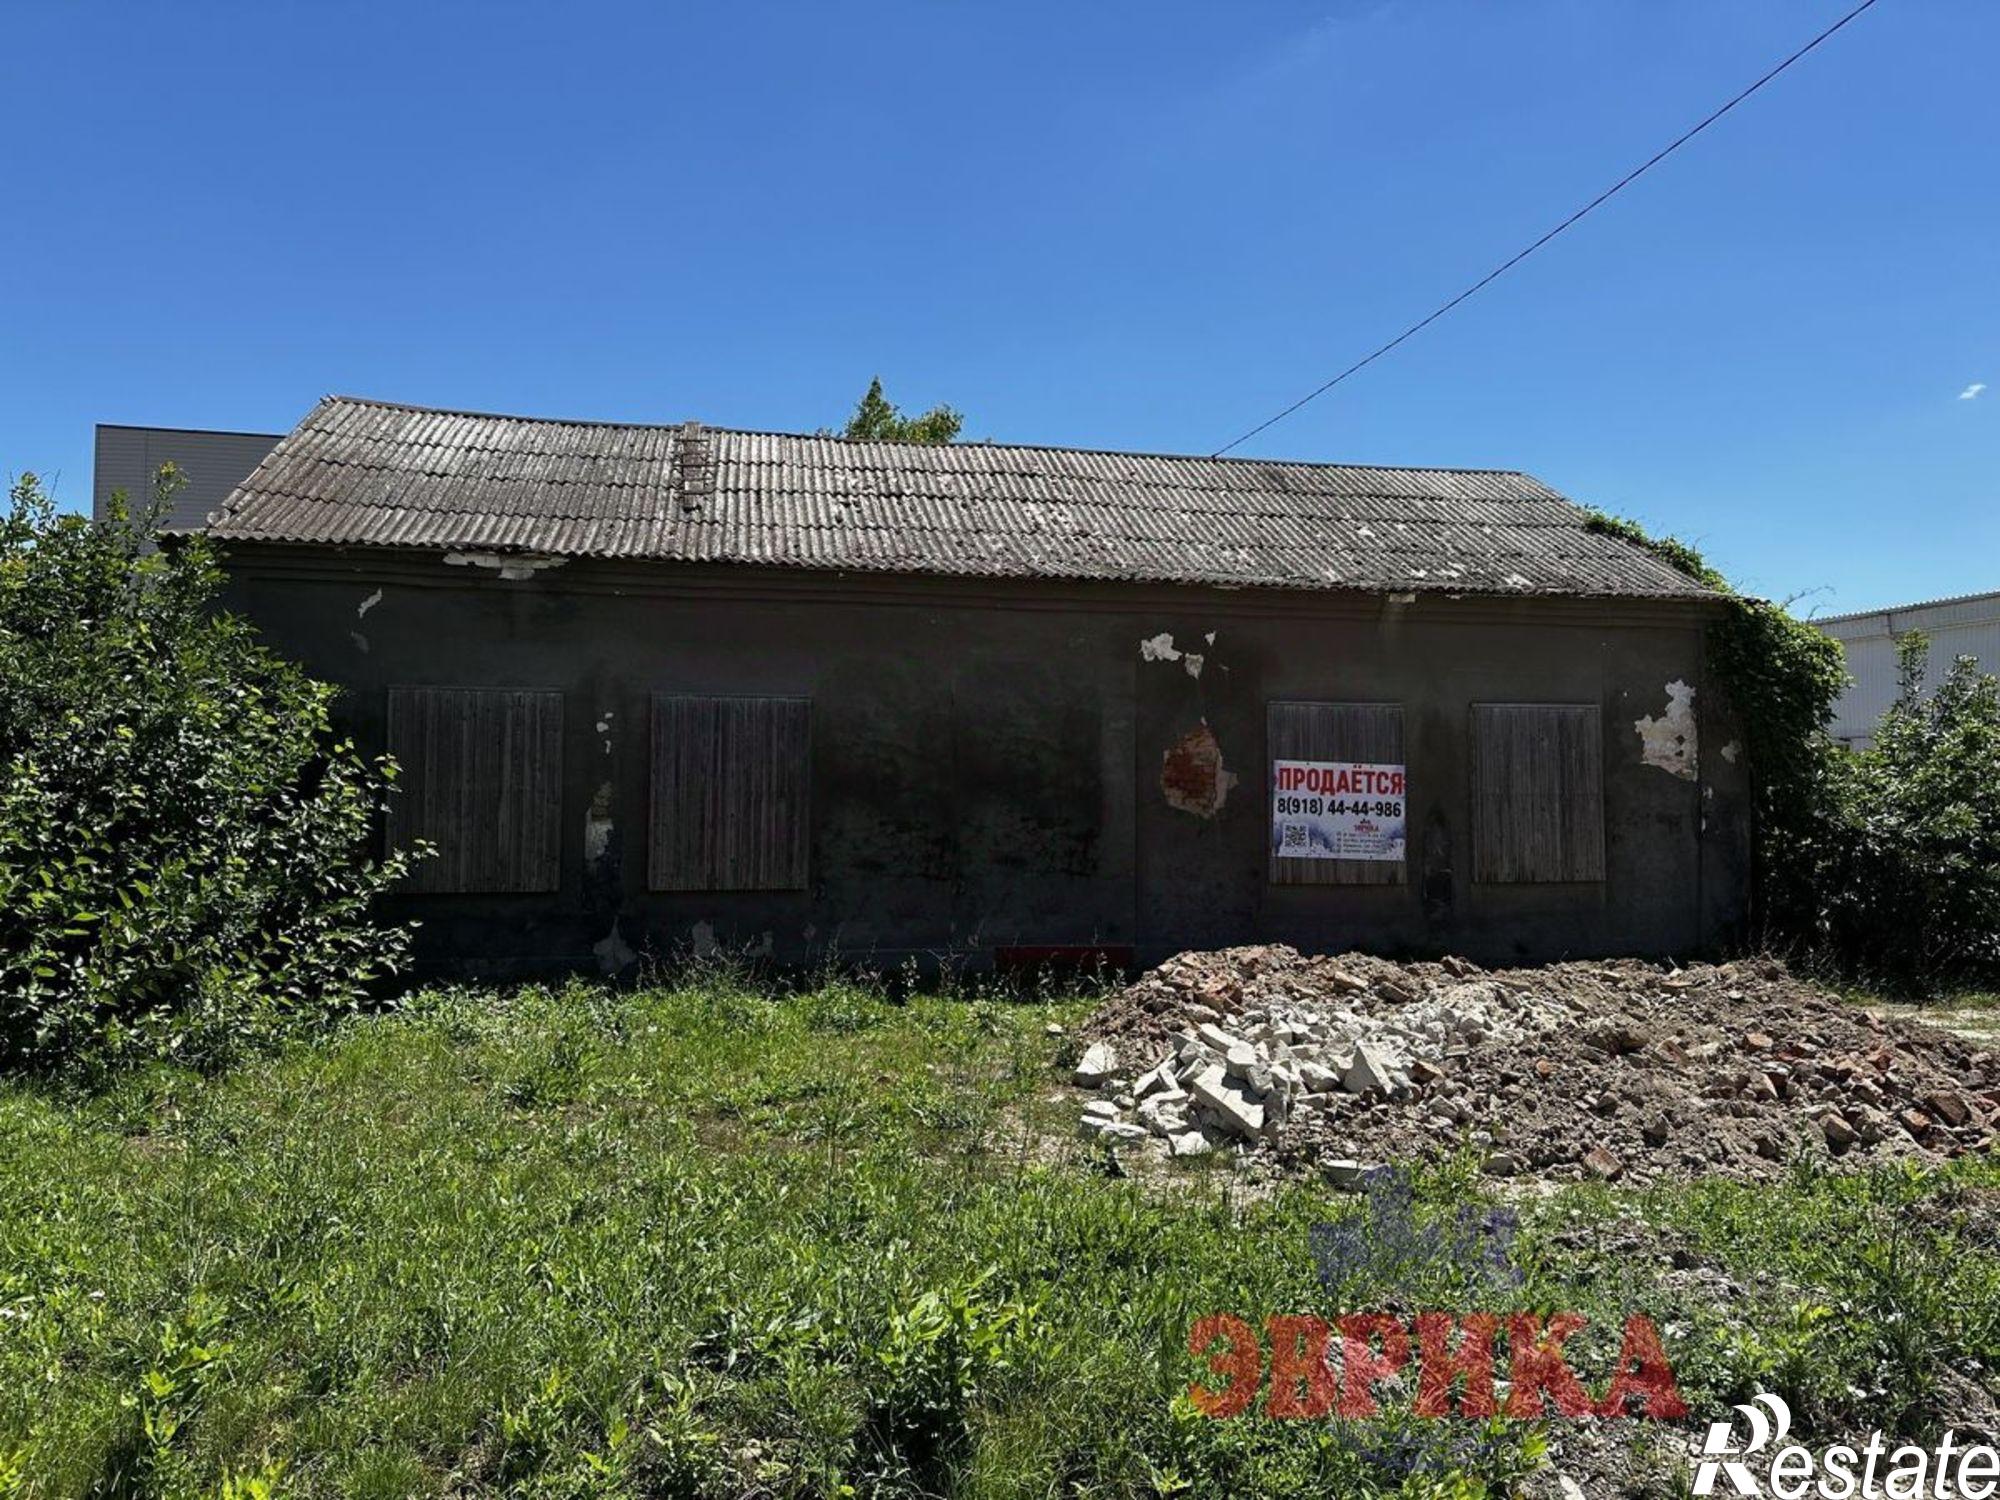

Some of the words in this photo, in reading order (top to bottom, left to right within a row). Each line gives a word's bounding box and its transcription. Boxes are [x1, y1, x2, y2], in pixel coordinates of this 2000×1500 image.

[1279, 765, 1403, 796] ПРОДАЁТСЯ
[1277, 796, 1323, 816] 8(918)
[1327, 800, 1402, 817] 44-44-986
